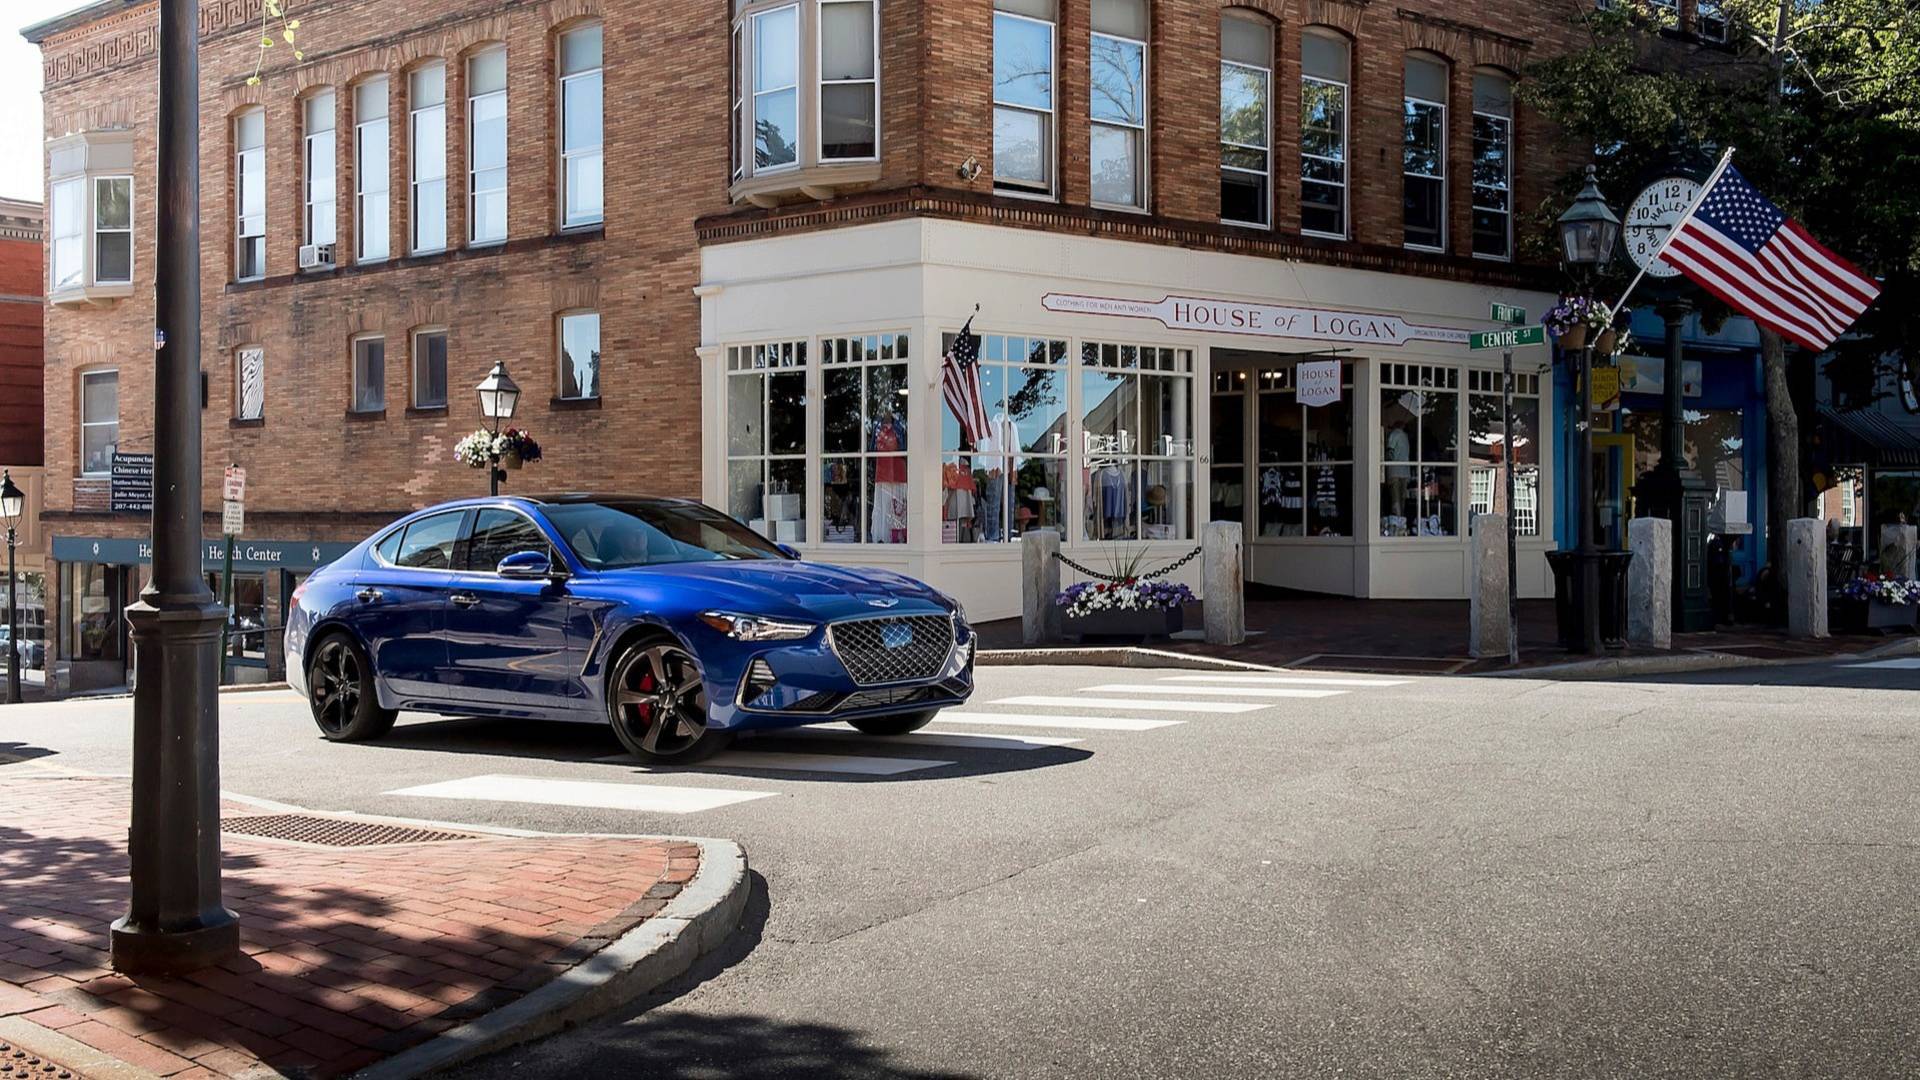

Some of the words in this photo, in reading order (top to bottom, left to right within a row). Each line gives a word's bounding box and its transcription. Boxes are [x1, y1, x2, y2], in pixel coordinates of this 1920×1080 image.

[1665, 185, 1680, 199] 12
[1687, 189, 1692, 201] 1
[1648, 193, 1659, 206] 11
[1636, 207, 1650, 220] 10
[1632, 225, 1641, 238] 9
[1646, 228, 1660, 248] DRU
[1637, 242, 1646, 255] 8
[1086, 301, 1099, 309] FOR
[1175, 303, 1262, 328] HOUSE
[1274, 314, 1302, 331] of
[1313, 315, 1397, 338] LOGAN
[1482, 331, 1518, 347] CENTRE
[1523, 330, 1532, 338] ST
[1302, 368, 1336, 380] HOUSE
[1301, 386, 1336, 397] LOGAN
[114, 455, 153, 464] Acupunctu
[1199, 455, 1209, 465] 66
[113, 466, 139, 474] Chinese
[140, 467, 152, 475] Her
[246, 546, 282, 561] Center
